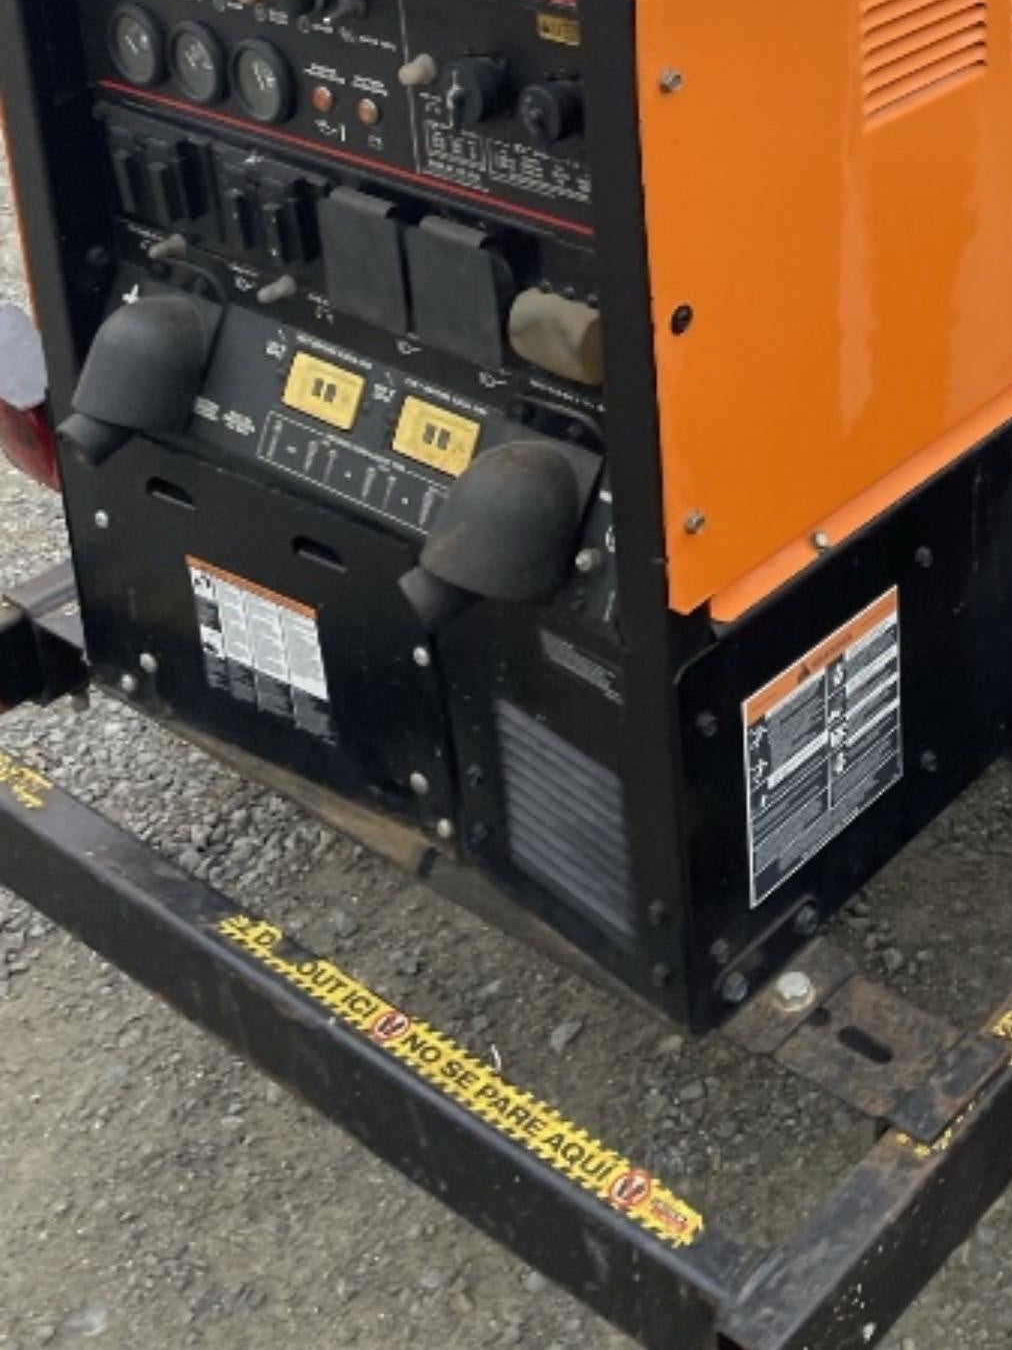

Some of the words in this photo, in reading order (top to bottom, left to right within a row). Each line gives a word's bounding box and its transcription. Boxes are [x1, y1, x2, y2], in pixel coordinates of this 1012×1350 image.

[340, 986, 379, 1019] ICI
[401, 1034, 442, 1064] NO
[440, 1060, 480, 1090] SE
[474, 1083, 548, 1137] PARE
